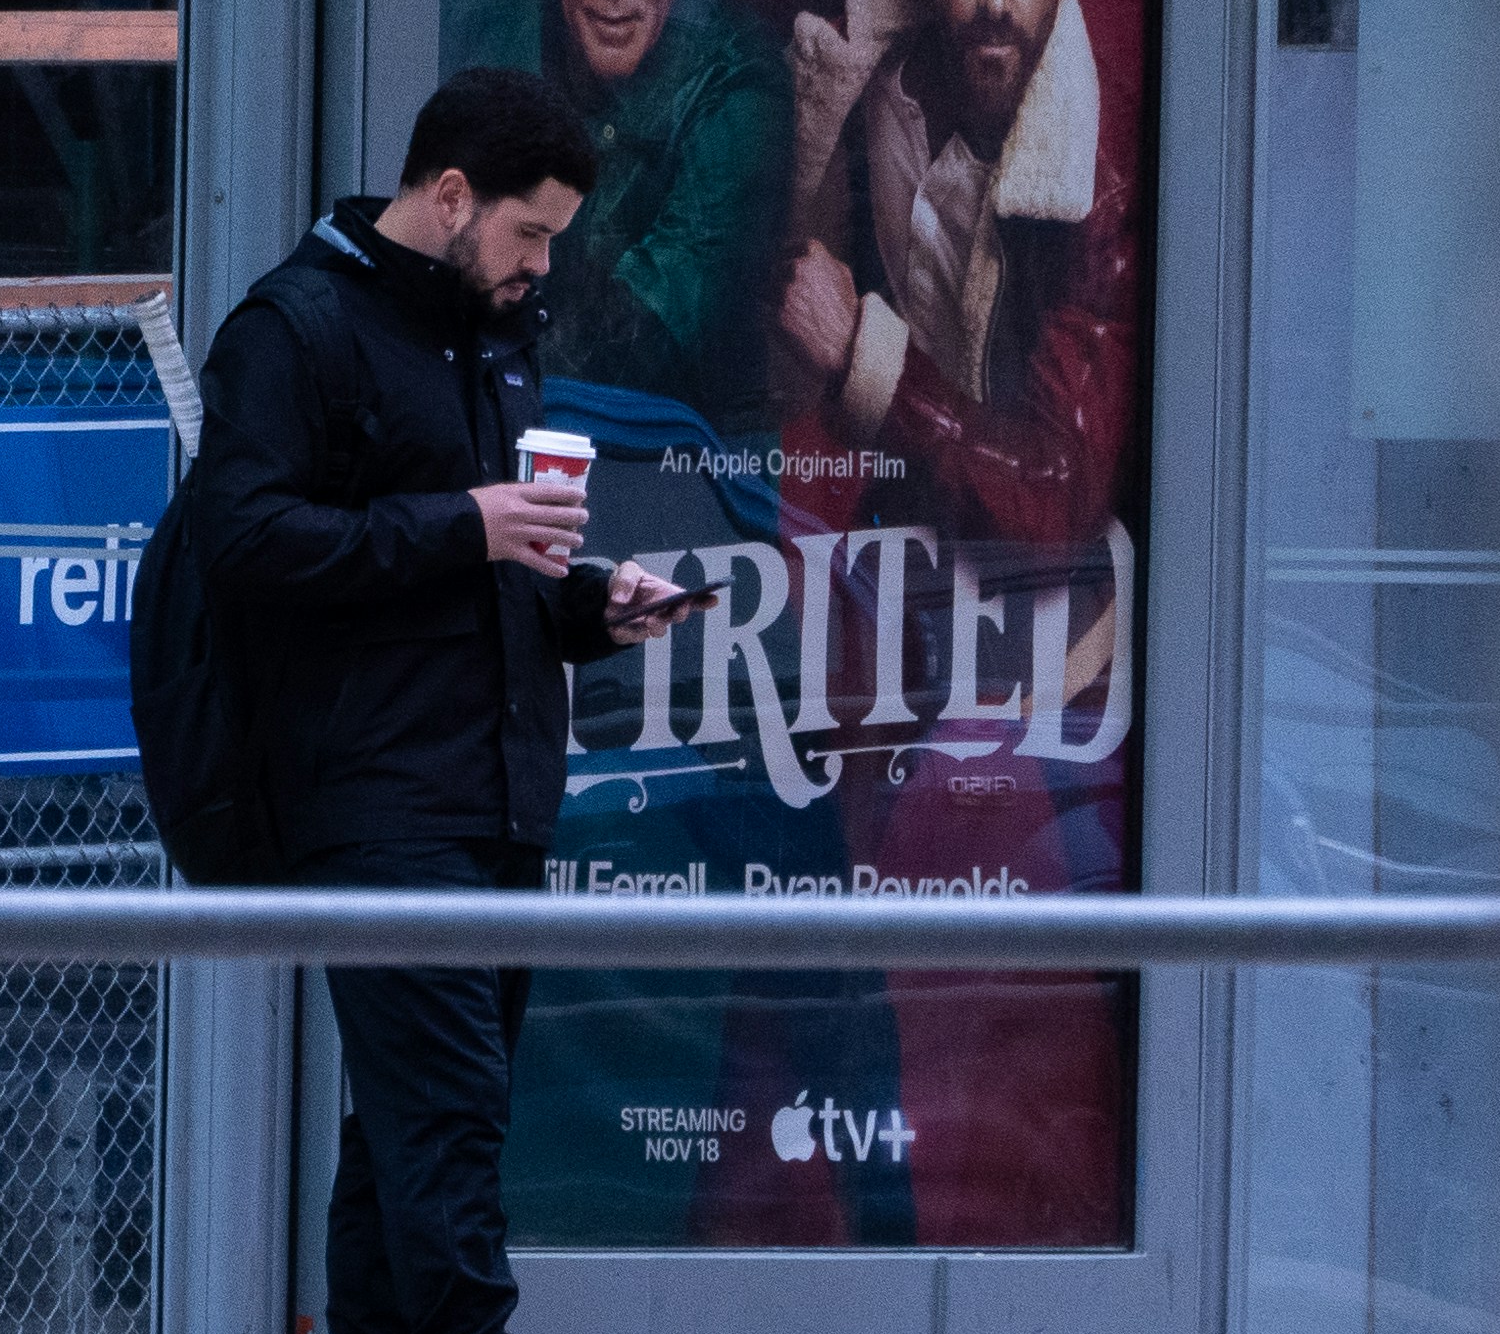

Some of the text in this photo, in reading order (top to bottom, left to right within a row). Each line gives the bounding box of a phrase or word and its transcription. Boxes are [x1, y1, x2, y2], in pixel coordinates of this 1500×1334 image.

[659, 445, 906, 483] An Apple Original Film
[566, 518, 1134, 809] IRITED
[545, 858, 577, 897] ill
[620, 1107, 746, 1133] STREAMING
[818, 1097, 916, 1162] tv+
[645, 1138, 721, 1162] NOV 18
